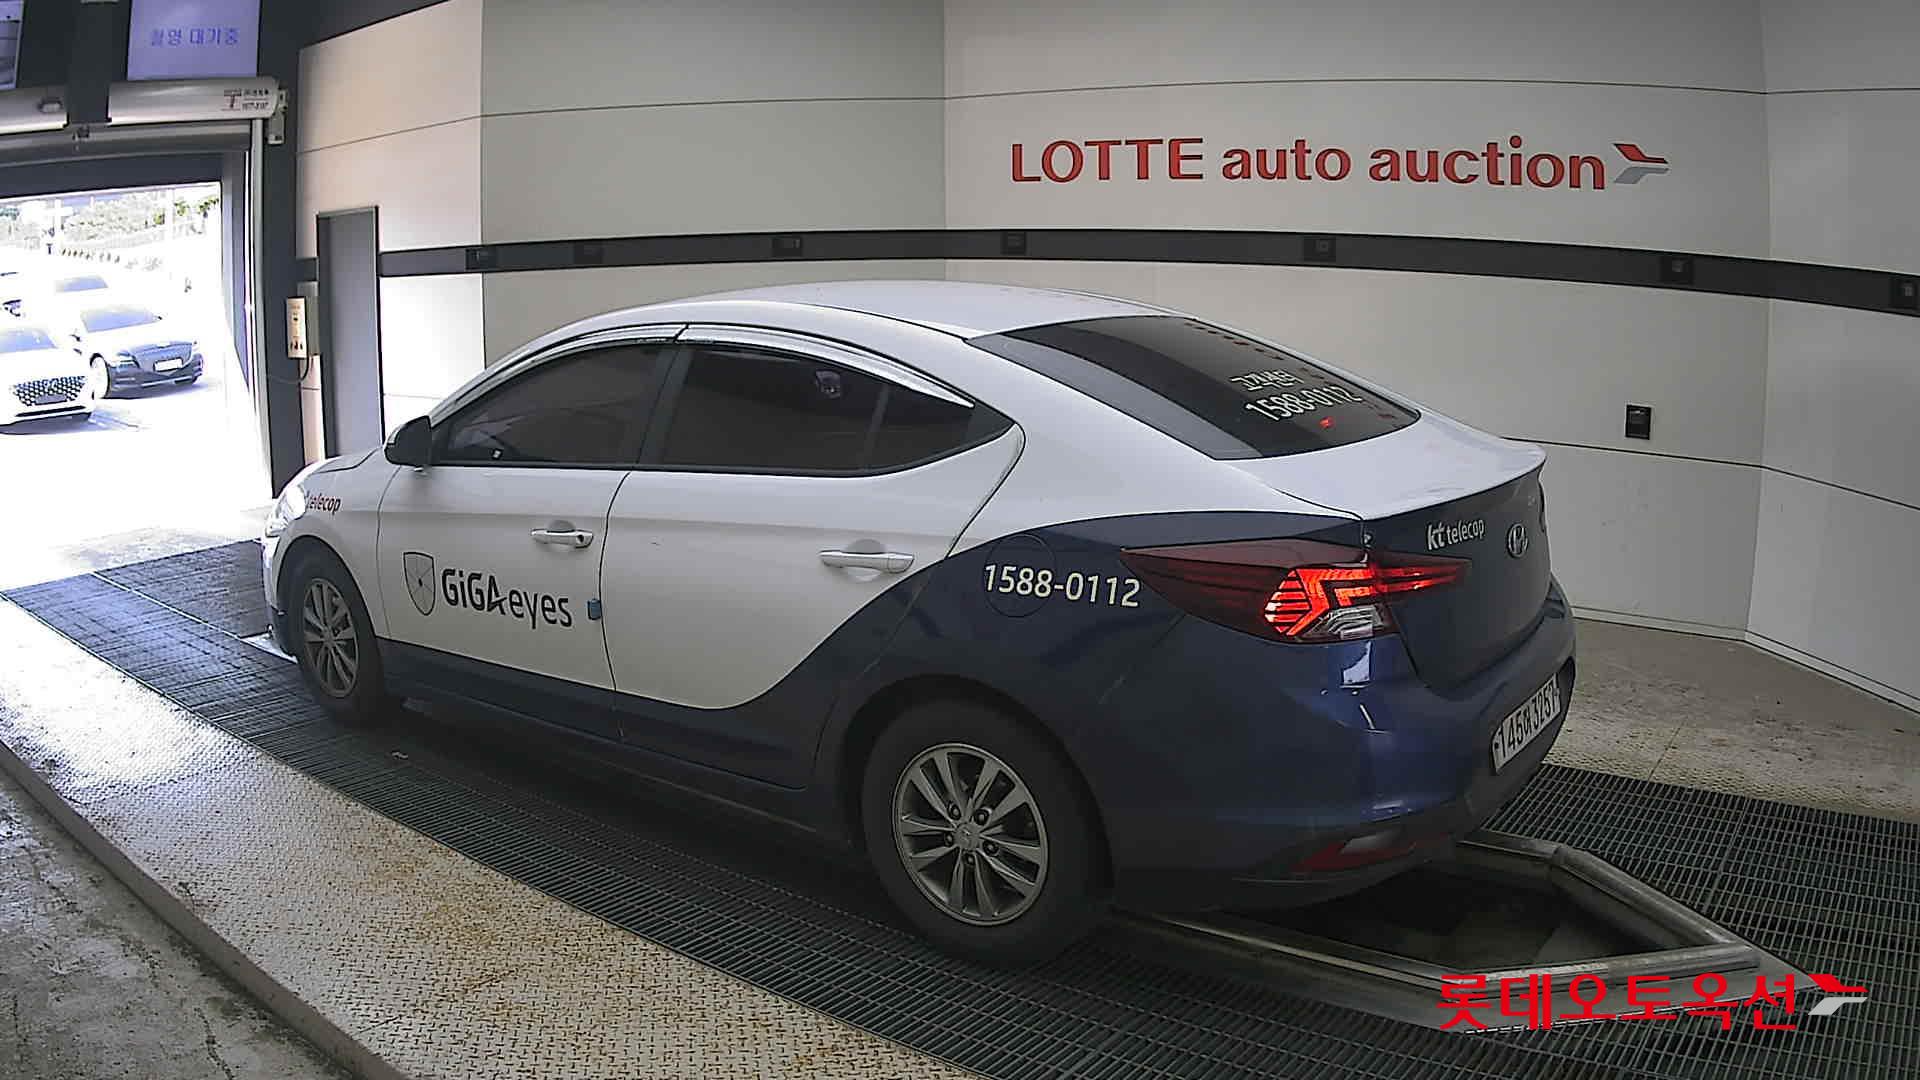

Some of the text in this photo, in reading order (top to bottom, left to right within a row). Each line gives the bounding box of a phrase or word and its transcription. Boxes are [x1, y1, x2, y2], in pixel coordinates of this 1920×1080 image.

[1011, 135, 1605, 190] LOTTE auto auction
[1245, 386, 1363, 421] 1588-0112
[1427, 519, 1485, 550] kt telecop
[985, 564, 1141, 607] 1588-0112
